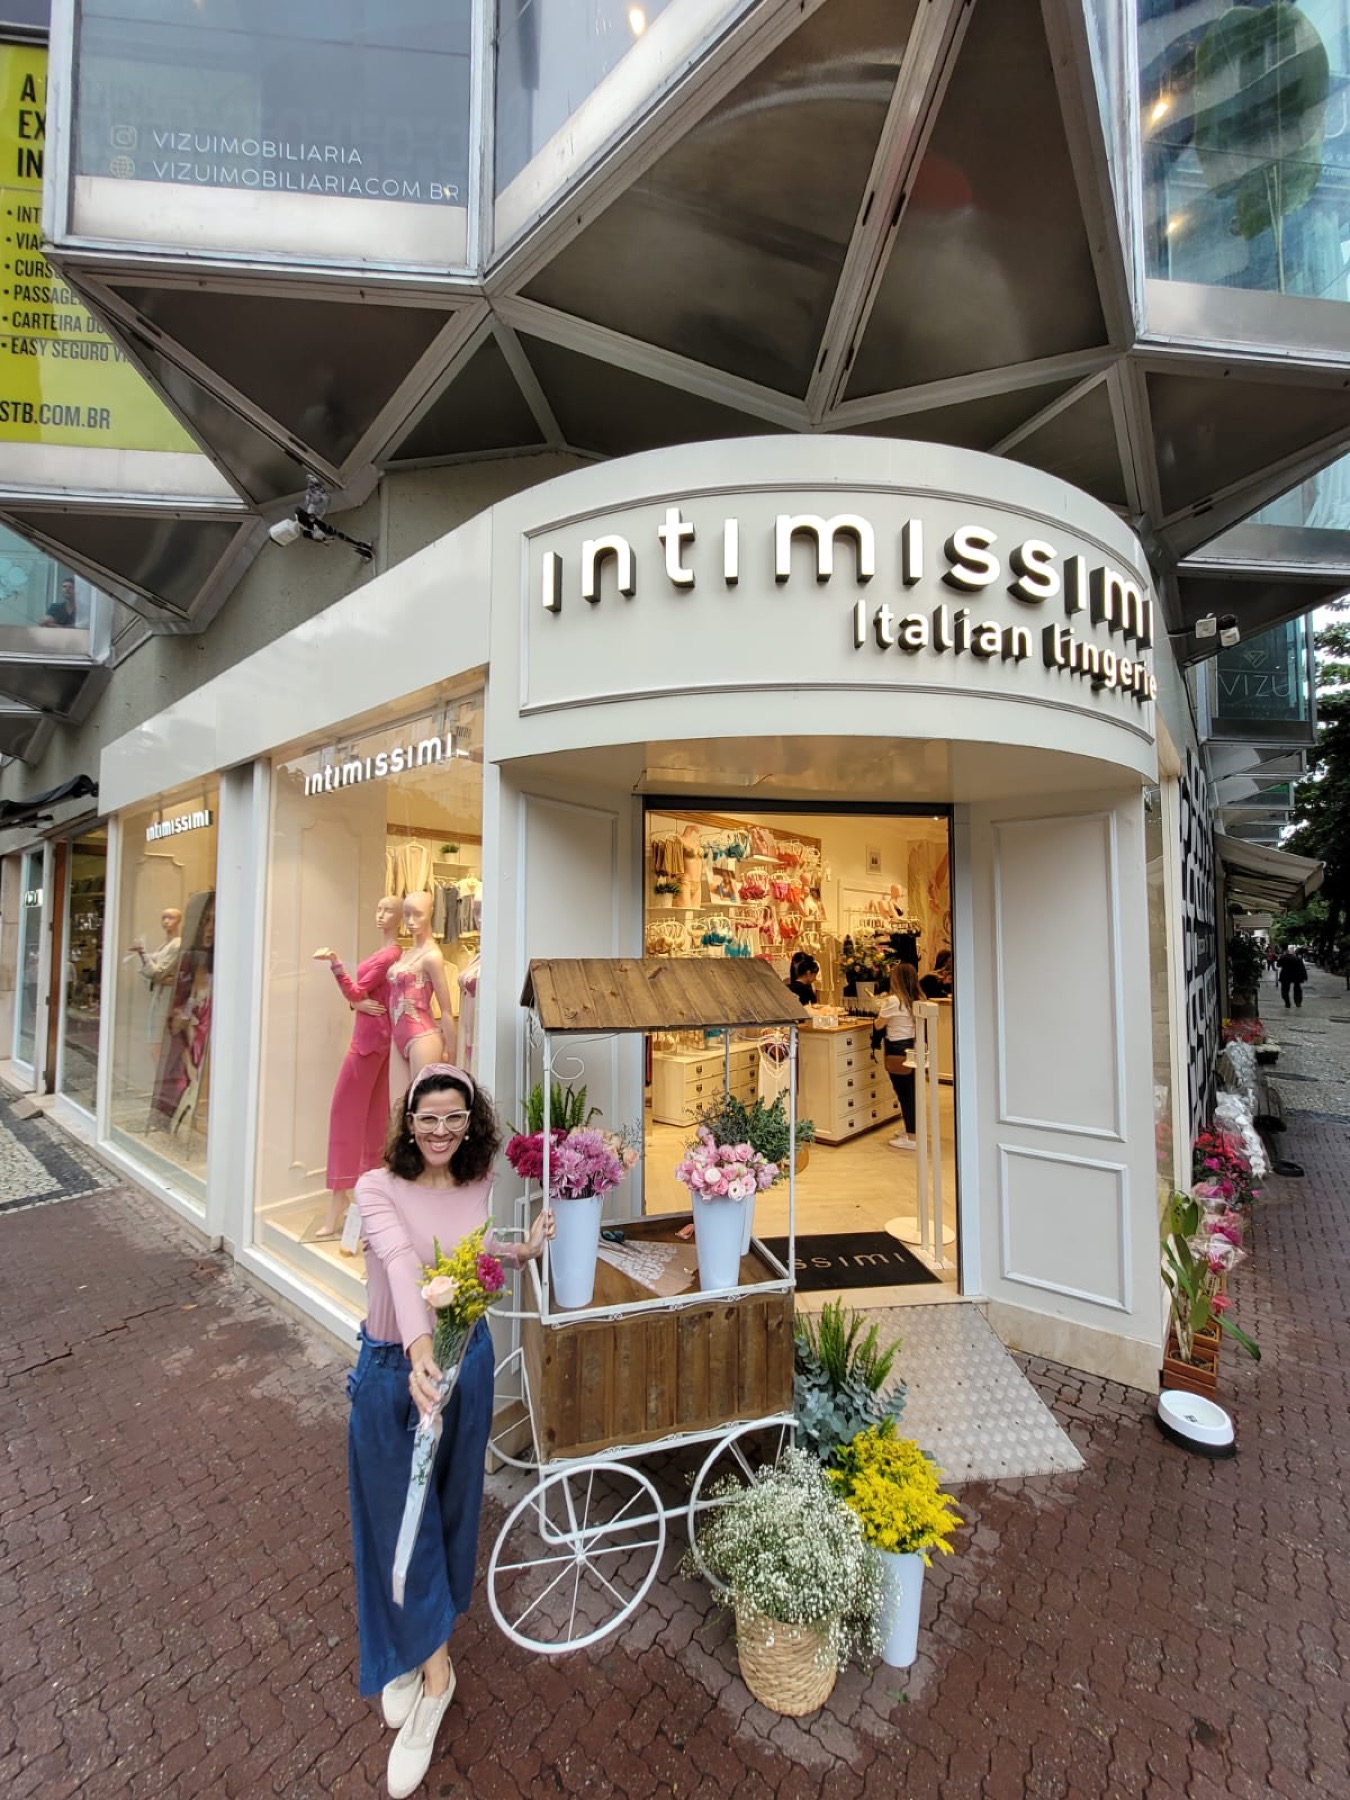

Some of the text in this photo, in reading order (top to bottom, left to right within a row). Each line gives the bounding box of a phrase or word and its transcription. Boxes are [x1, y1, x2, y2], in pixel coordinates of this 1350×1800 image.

[20, 73, 36, 103] A
[152, 129, 363, 165] VIZUIMOBILIARIA
[14, 259, 61, 280] CURS
[12, 310, 82, 333] CARTEIRA
[10, 336, 48, 357] EASY
[51, 340, 109, 362] SEGURO
[0, 400, 111, 430] STB.COM.BR
[541, 506, 1154, 650] intimissimi
[854, 599, 1157, 701] Italian lingerie
[1217, 673, 1291, 698] VIZU
[303, 732, 453, 796] intimissimi
